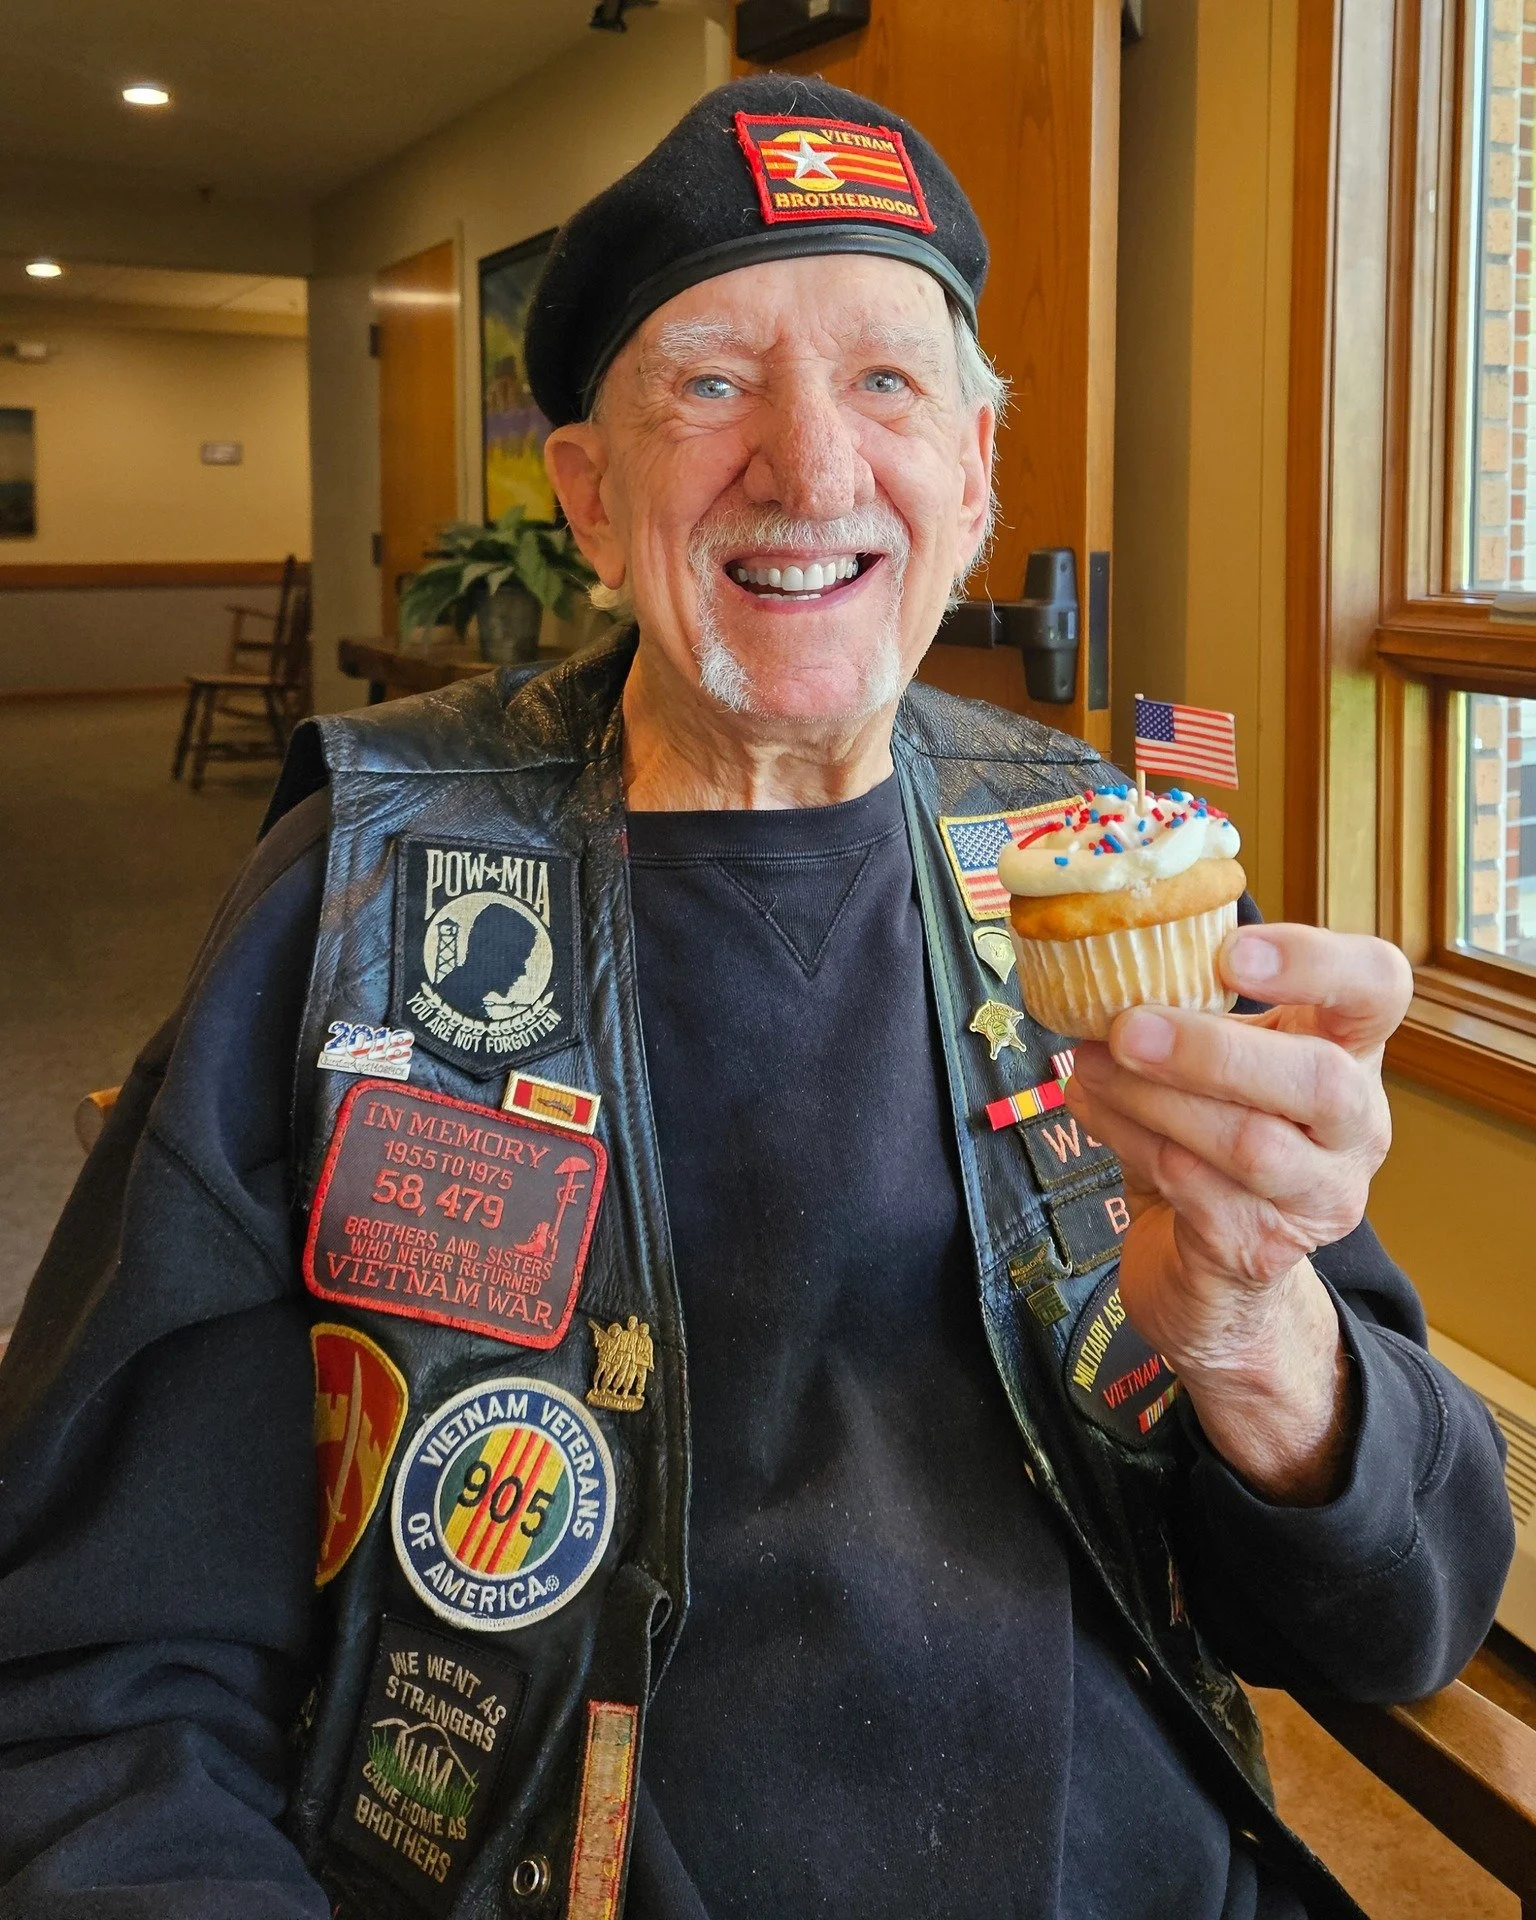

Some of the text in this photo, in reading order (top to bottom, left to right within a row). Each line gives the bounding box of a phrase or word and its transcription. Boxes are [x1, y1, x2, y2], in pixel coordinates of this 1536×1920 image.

[820, 129, 896, 154] VIETNAM
[774, 192, 920, 217] BROTHERHOOD
[424, 849, 551, 928] POW MIA
[324, 1021, 415, 1065] 2018
[406, 991, 562, 1053] YOU ARE NOT FORGOTTEN
[363, 1102, 550, 1168] IN MEMORY
[384, 1140, 514, 1191] 1955 TO 1975
[344, 1215, 553, 1280] BROTHERS AND SISTERS
[351, 1236, 542, 1295] WHO NEVER RETURNED
[326, 1251, 554, 1330] VIETNAM WAR
[1072, 1314, 1113, 1393] MILITARY
[1103, 1354, 1161, 1410] VIETNAM
[420, 1393, 600, 1541] VIETNAM VETERANS
[457, 1460, 555, 1538] 905
[408, 1512, 437, 1551] OF
[385, 1674, 497, 1752] STRANGERS
[389, 1651, 507, 1726] WE WENT AS
[393, 1728, 454, 1796] NAM
[361, 1760, 468, 1841] CAME HOME AS
[355, 1793, 452, 1884] BROTHERS
